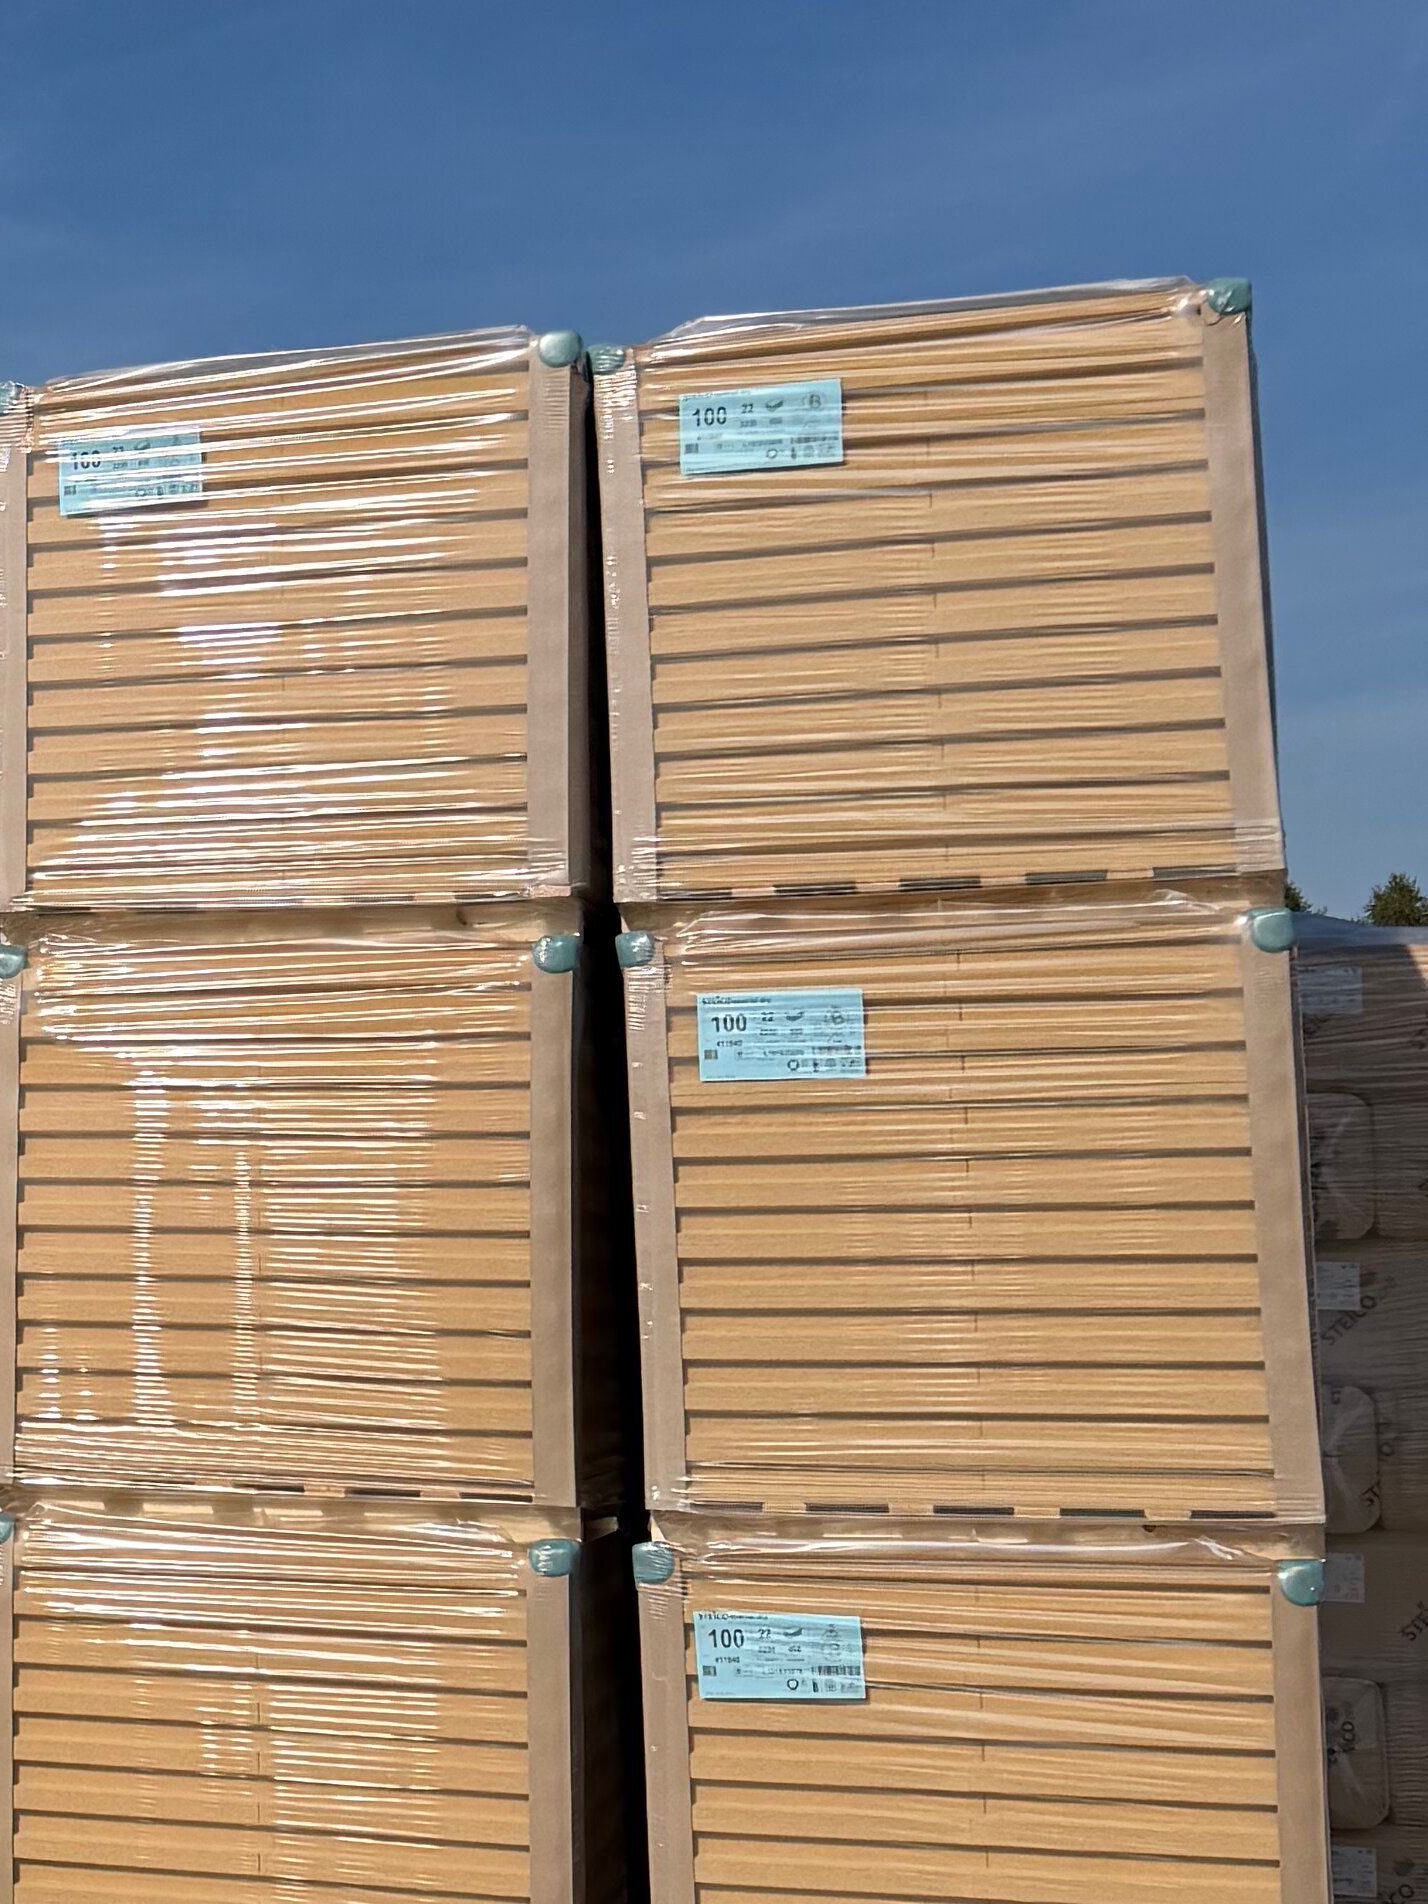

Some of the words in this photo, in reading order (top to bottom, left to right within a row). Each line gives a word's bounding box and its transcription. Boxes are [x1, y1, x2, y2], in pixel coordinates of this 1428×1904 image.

[692, 406, 727, 428] 100
[70, 450, 102, 471] 100
[711, 1013, 748, 1033] 100
[709, 1628, 745, 1649] 100
